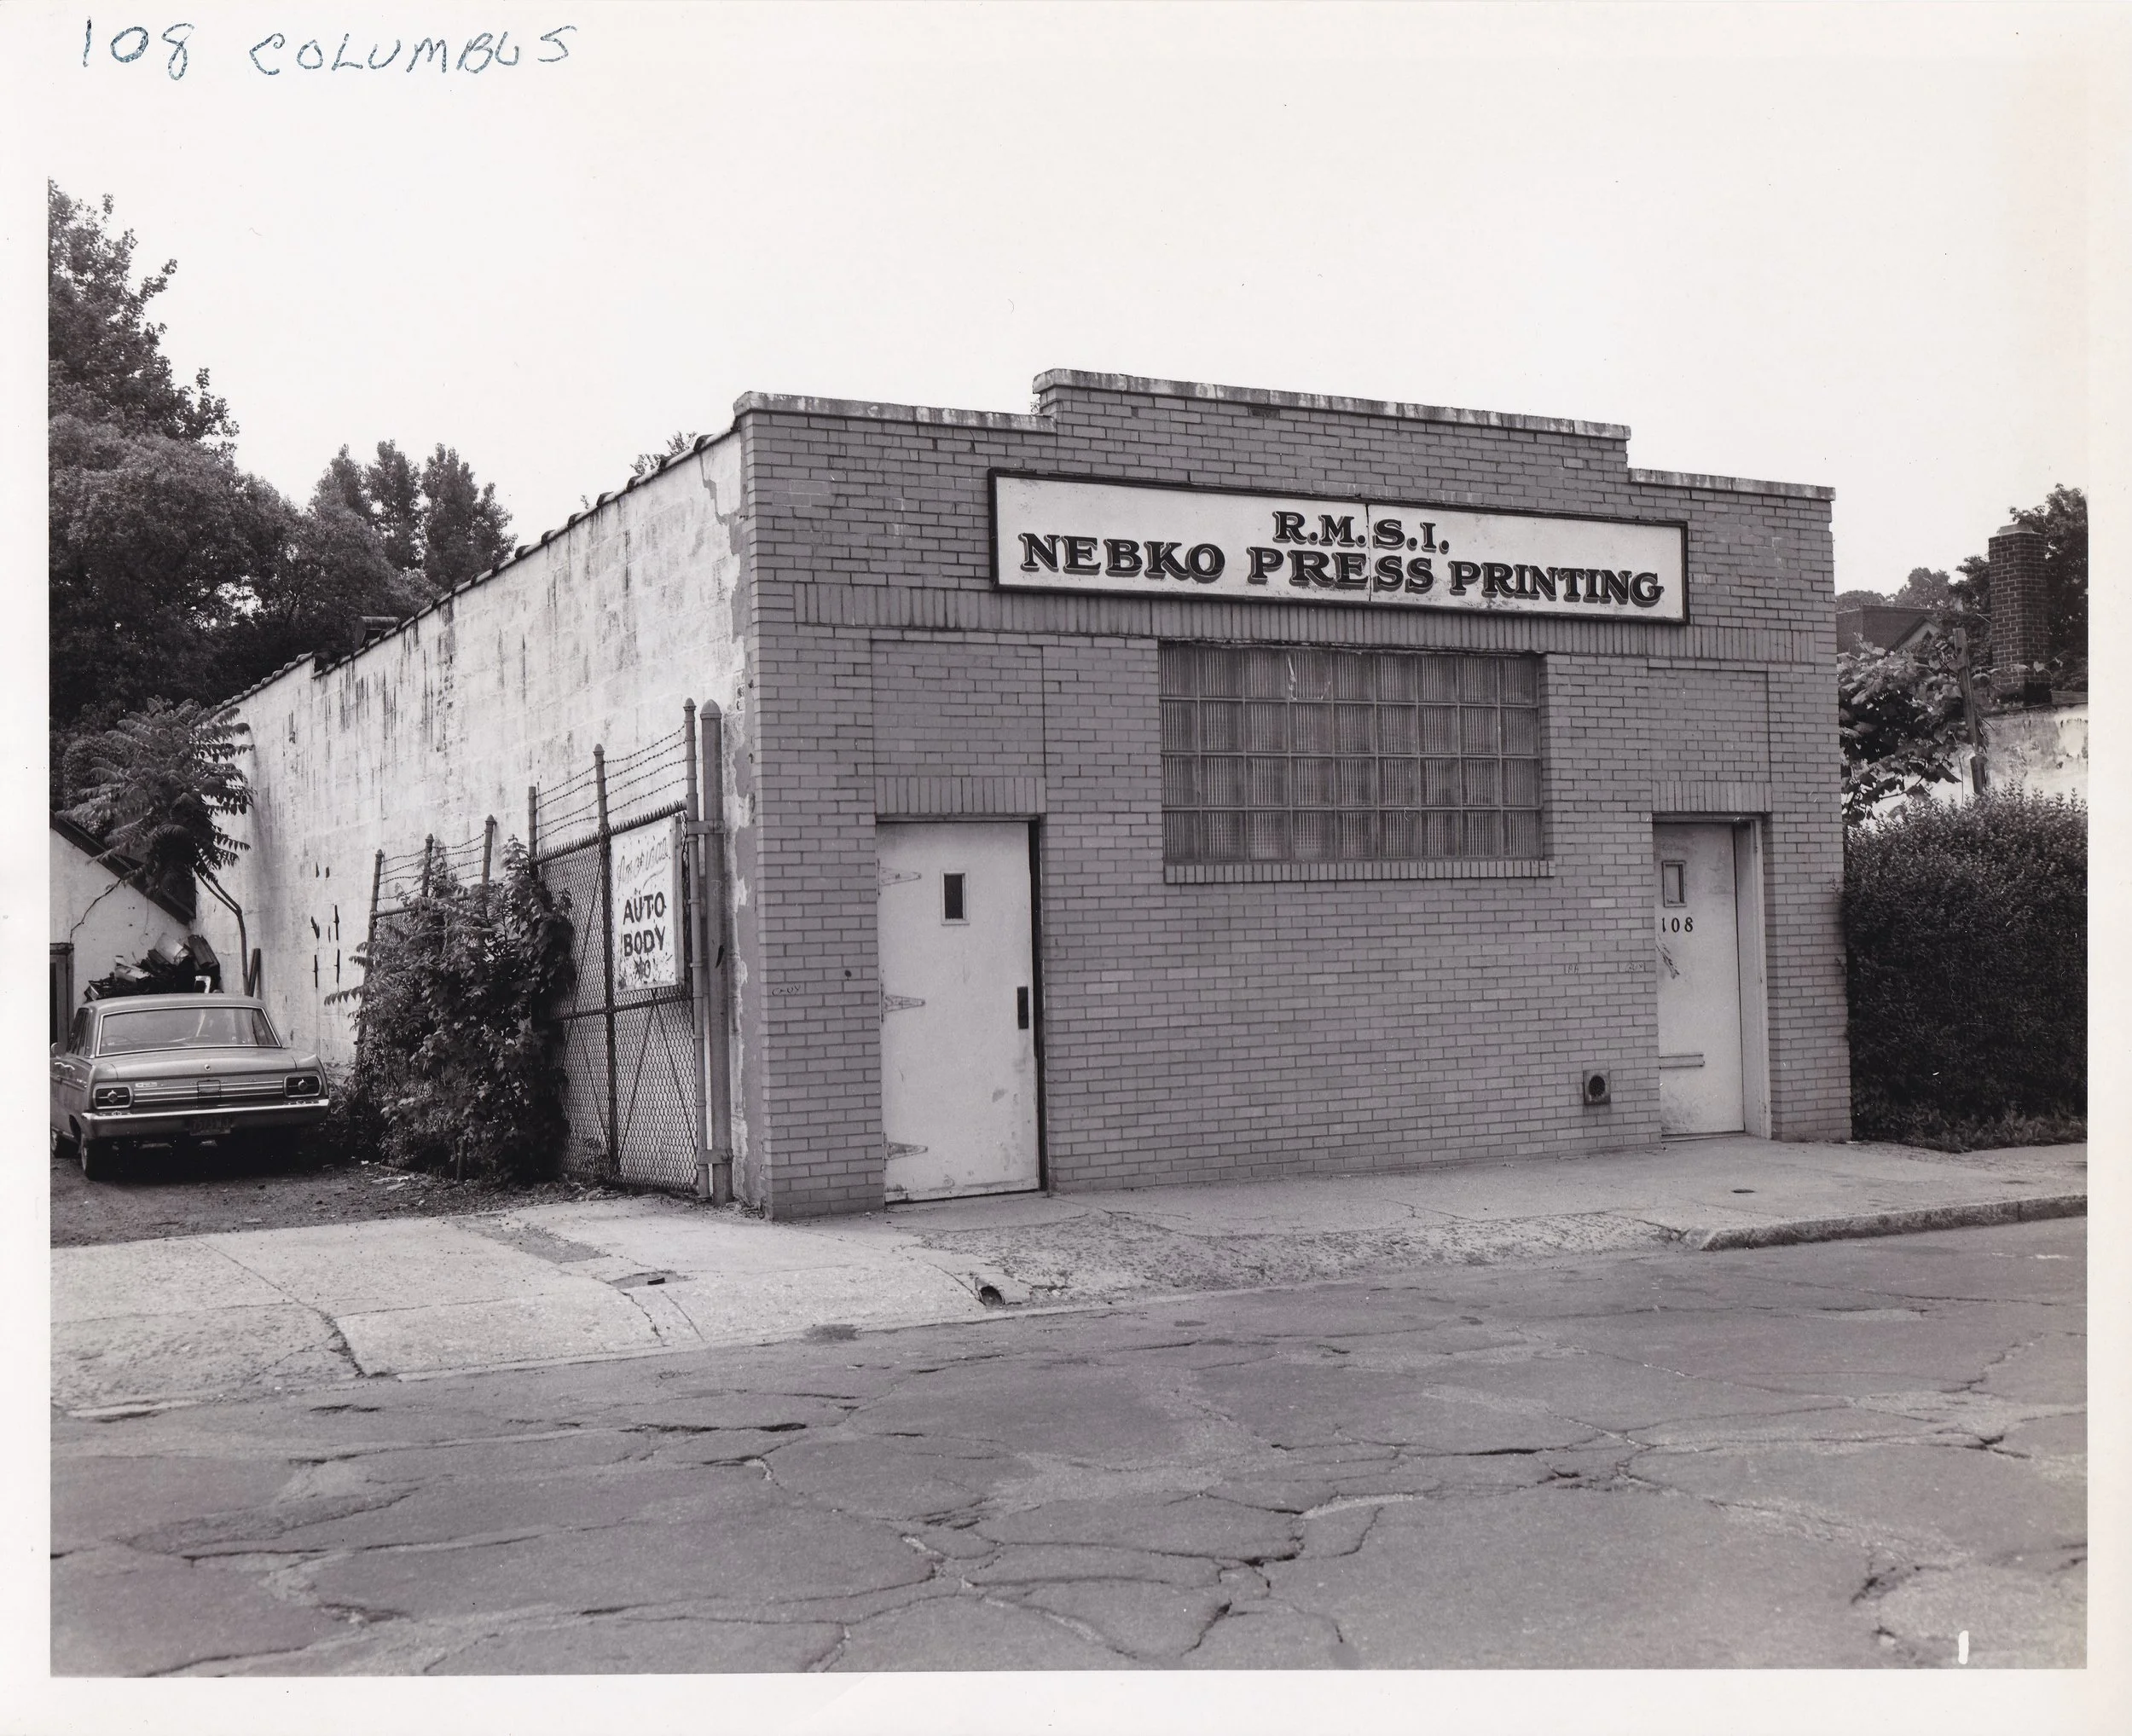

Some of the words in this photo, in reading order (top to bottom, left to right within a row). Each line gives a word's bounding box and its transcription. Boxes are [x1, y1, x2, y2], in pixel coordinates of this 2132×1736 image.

[83, 17, 195, 80] 108
[249, 26, 578, 76] COLUMBUS
[1272, 510, 1450, 555] R.M.S.I.
[1018, 532, 1225, 584] NEBKO
[1246, 547, 1434, 594] PRESS
[1448, 560, 1665, 608] PRINTING
[623, 891, 667, 925] AUTO
[1661, 917, 1694, 933] 108
[623, 925, 666, 958] BODY
